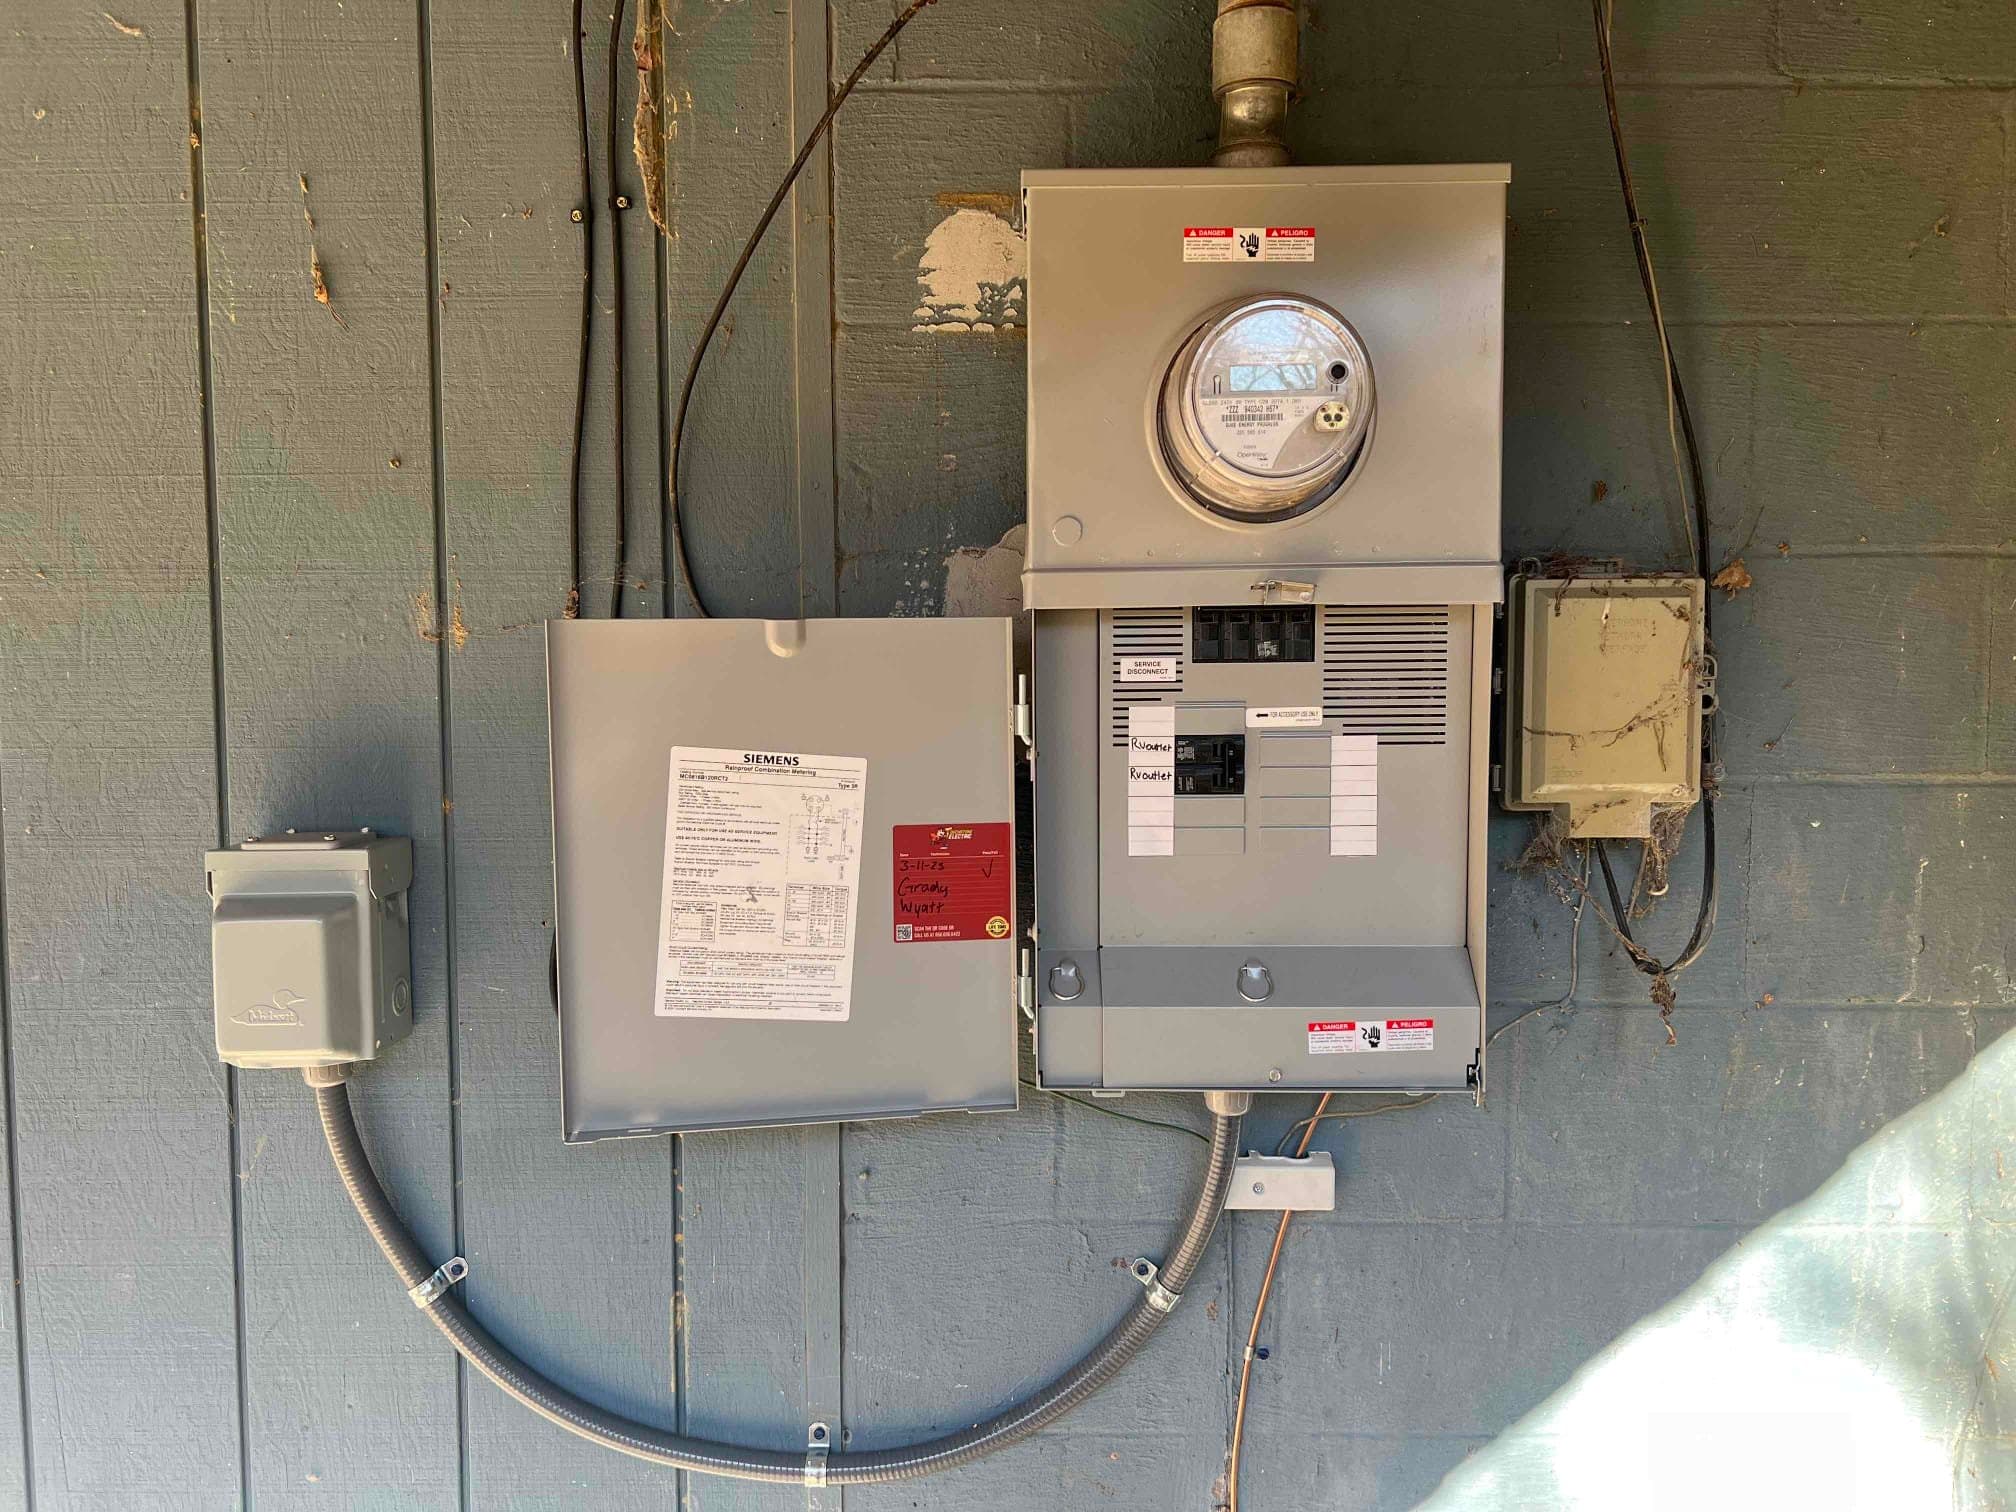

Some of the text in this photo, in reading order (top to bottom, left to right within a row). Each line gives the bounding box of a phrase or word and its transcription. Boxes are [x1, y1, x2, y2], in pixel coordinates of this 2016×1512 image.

[743, 753, 799, 766] SIEMENS
[754, 766, 790, 774] Combination
[791, 769, 817, 777] Metering
[898, 877, 949, 897] Grady
[900, 898, 944, 918] Wyatt
